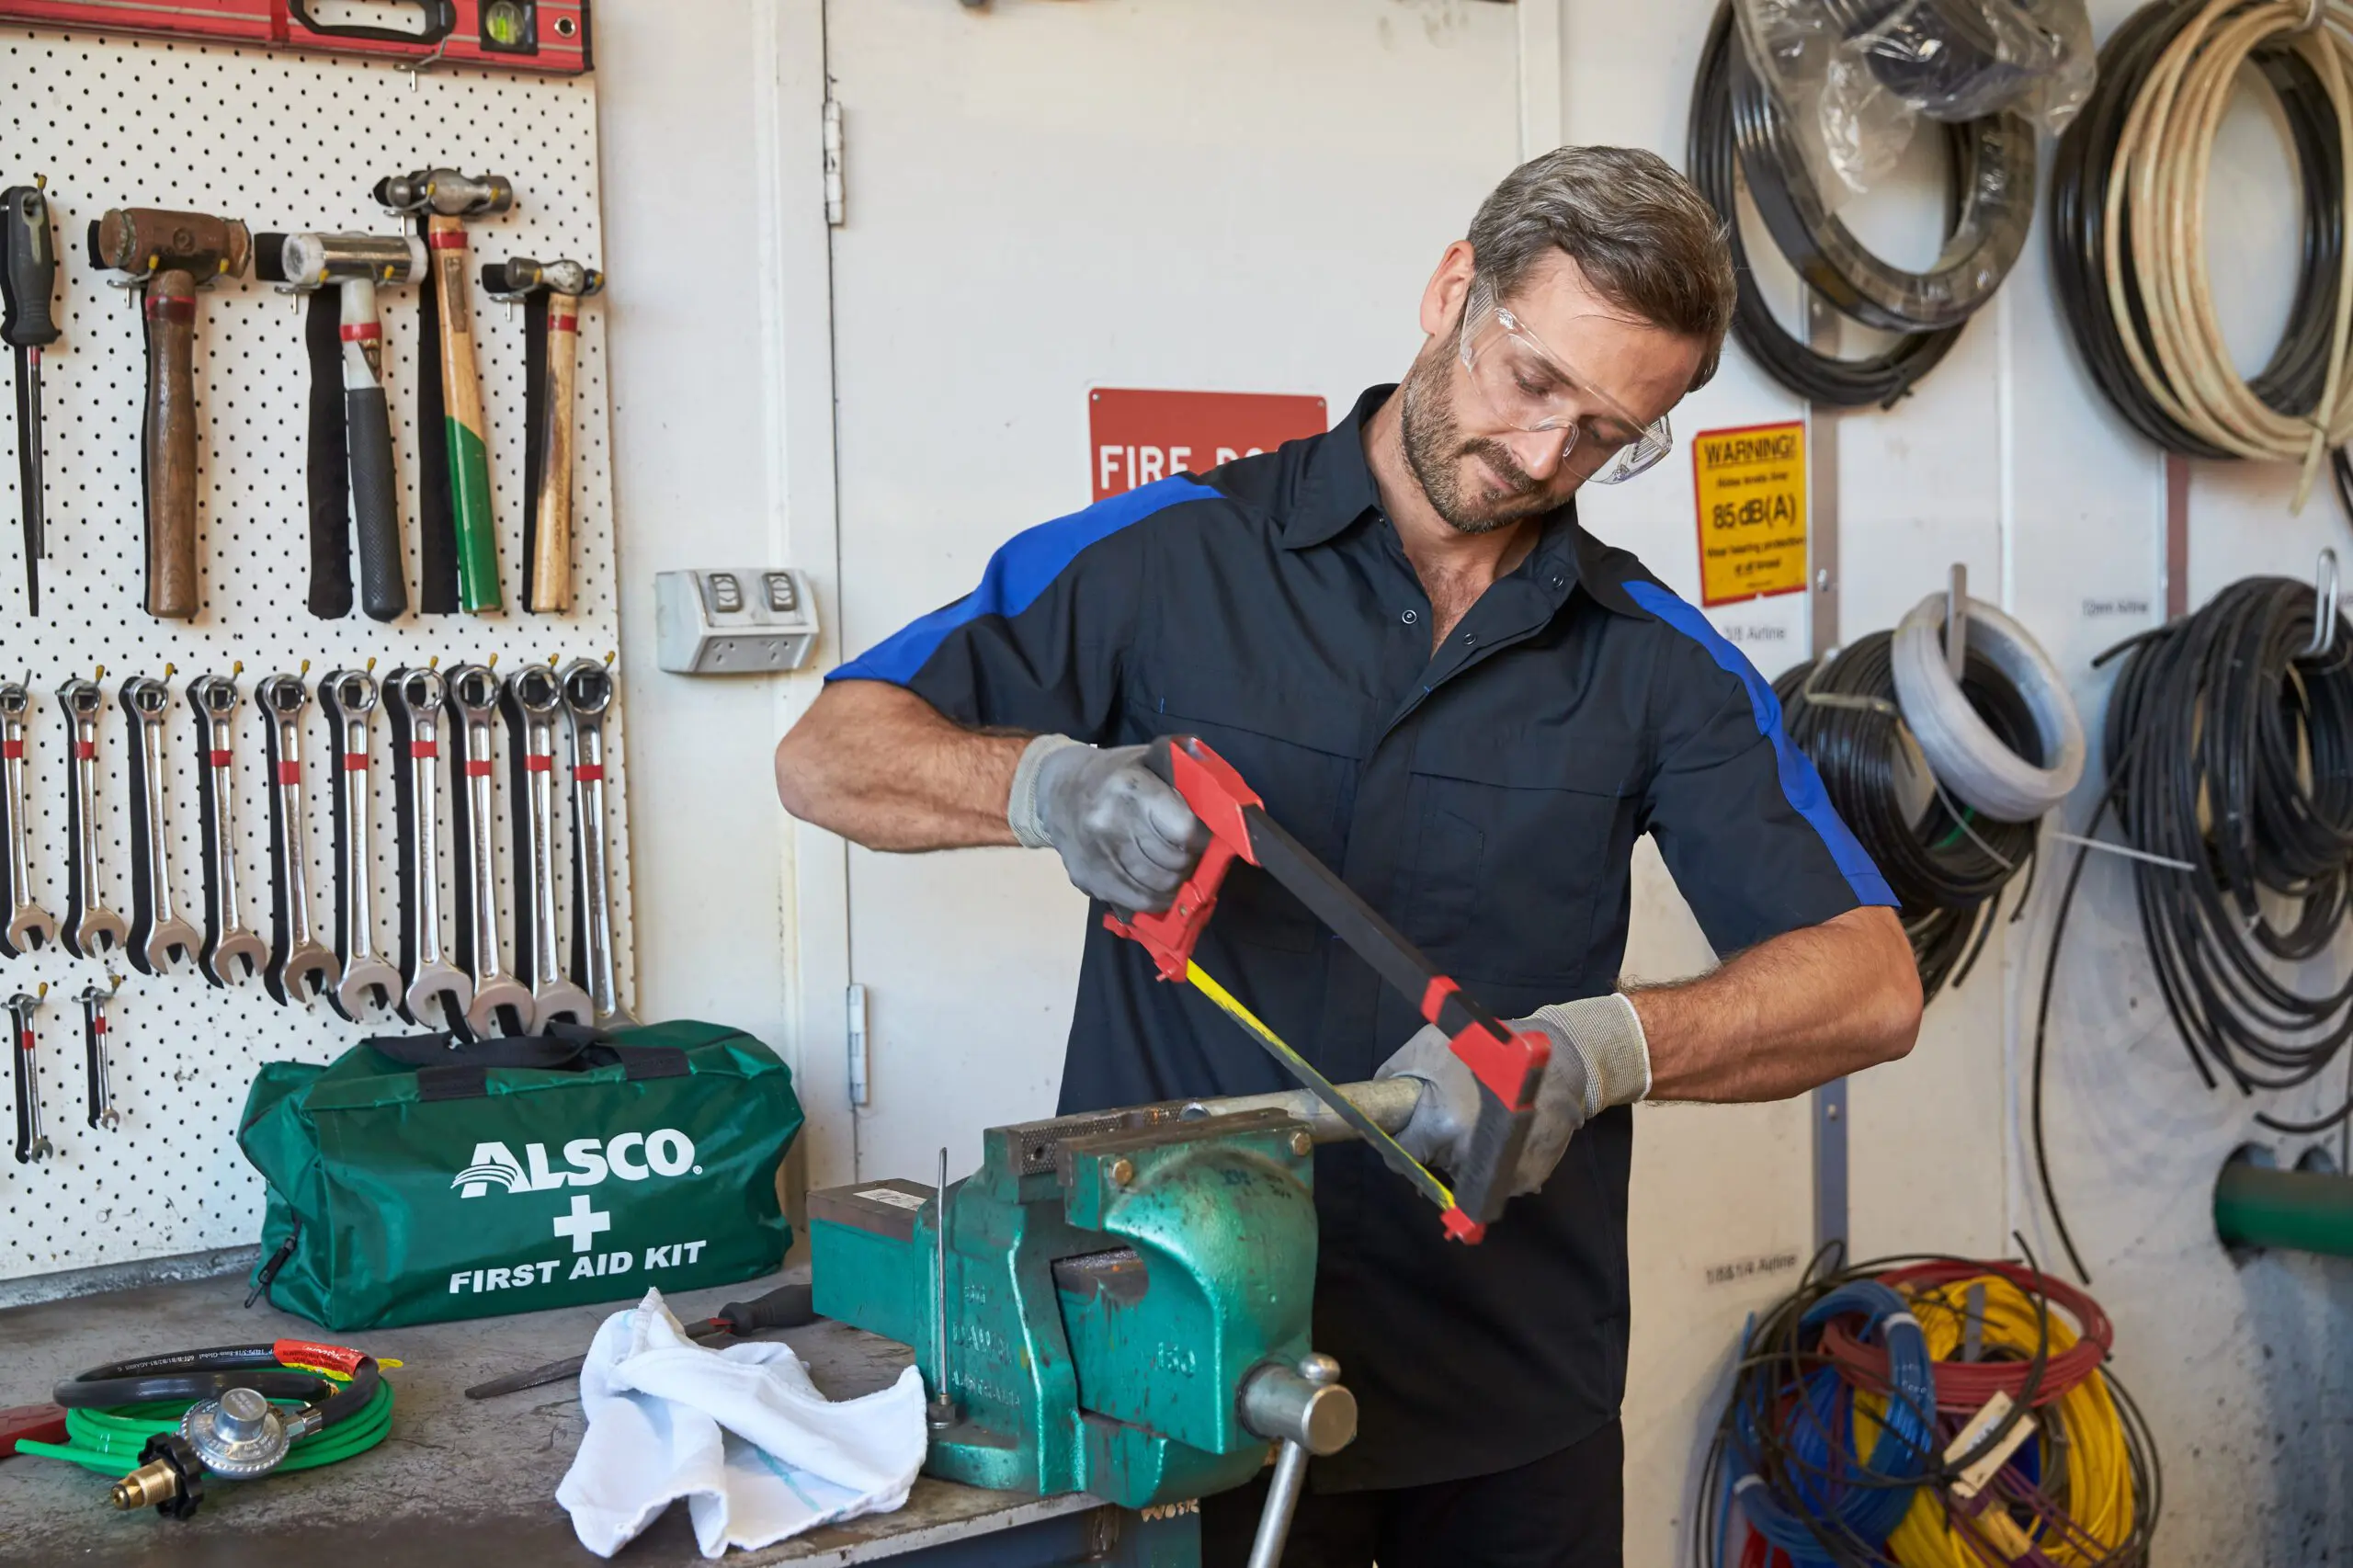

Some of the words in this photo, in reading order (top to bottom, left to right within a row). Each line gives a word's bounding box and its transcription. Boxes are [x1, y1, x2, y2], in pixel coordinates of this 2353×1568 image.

[1099, 445, 1191, 490] FIRE
[1703, 434, 1797, 465] WARNING!
[450, 1128, 696, 1199] ALSCO
[449, 1260, 561, 1294] FIRST
[568, 1251, 633, 1280] AID
[644, 1240, 707, 1270] KIT
